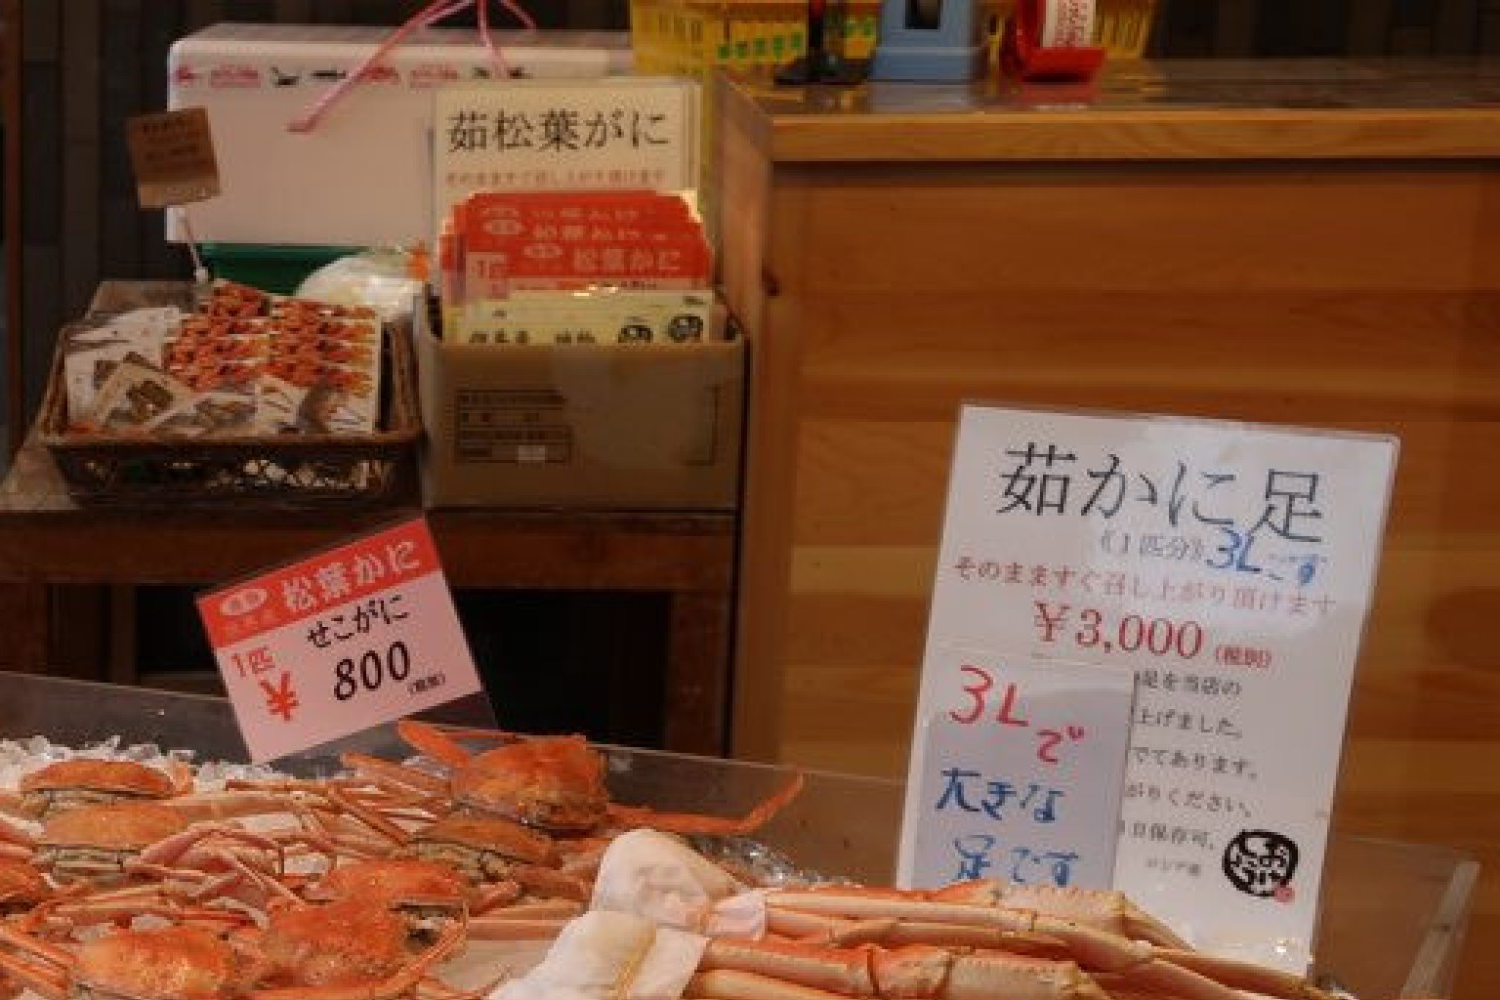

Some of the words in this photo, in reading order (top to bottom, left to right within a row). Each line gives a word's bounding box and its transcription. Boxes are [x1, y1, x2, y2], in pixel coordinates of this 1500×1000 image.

[446, 109, 670, 151] 茹松葉がに
[997, 441, 1322, 543] 茹かに足
[954, 555, 1338, 617] そのまますぐ召し上がり頂けます
[307, 595, 410, 649] せこがに
[1034, 602, 1204, 660] ¥3,000
[333, 641, 410, 700] 800
[935, 767, 1065, 824] 大きな
